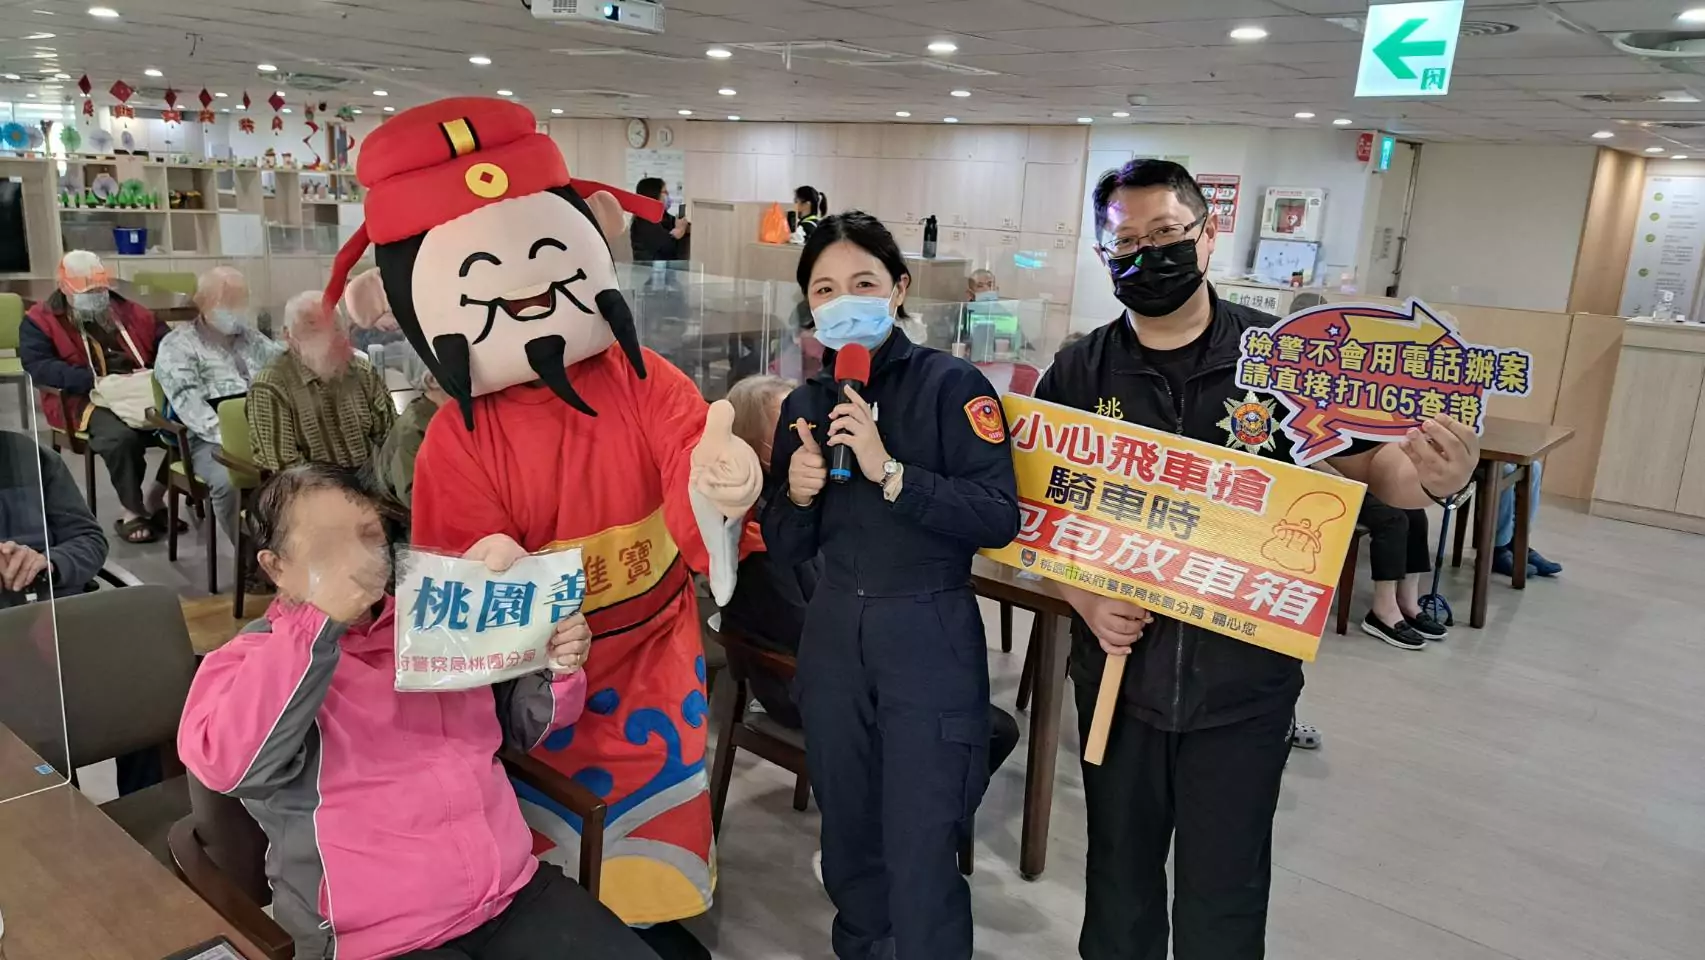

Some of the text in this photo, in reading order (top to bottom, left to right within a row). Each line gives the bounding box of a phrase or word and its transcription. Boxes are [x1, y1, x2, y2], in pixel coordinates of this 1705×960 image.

[1241, 361, 1479, 427] 請直接打165查證
[1246, 332, 1530, 393] 檢警不會用電話辦案
[1094, 397, 1124, 419] 桃
[1010, 414, 1272, 515] 小心飛車搶
[1045, 465, 1201, 541] 騎車時
